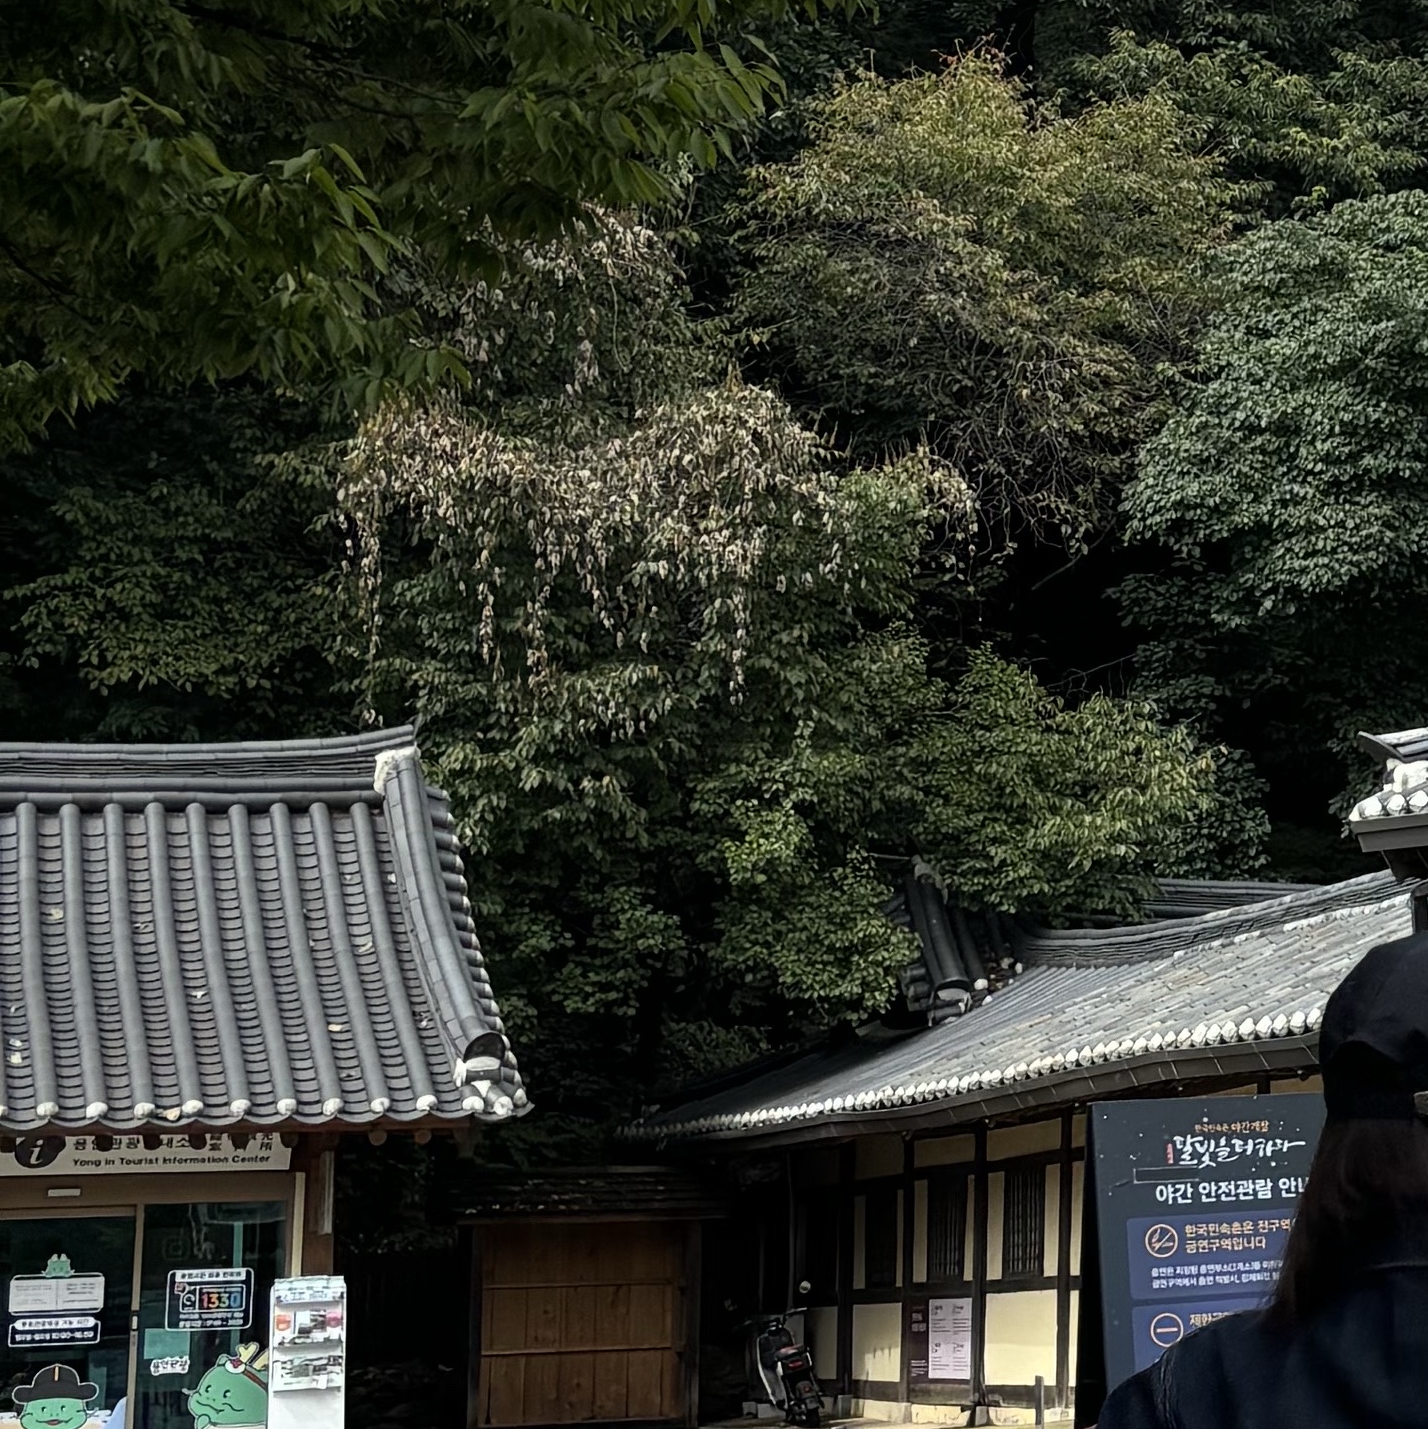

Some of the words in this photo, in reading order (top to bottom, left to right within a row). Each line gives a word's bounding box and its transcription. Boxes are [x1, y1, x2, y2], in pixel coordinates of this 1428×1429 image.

[119, 1156, 158, 1166] Tourist
[162, 1155, 229, 1165] Information
[232, 1154, 271, 1163] Center
[1155, 1184, 1193, 1205] 야간
[1199, 1179, 1273, 1202] 안전관람
[201, 1292, 241, 1309] 1330
